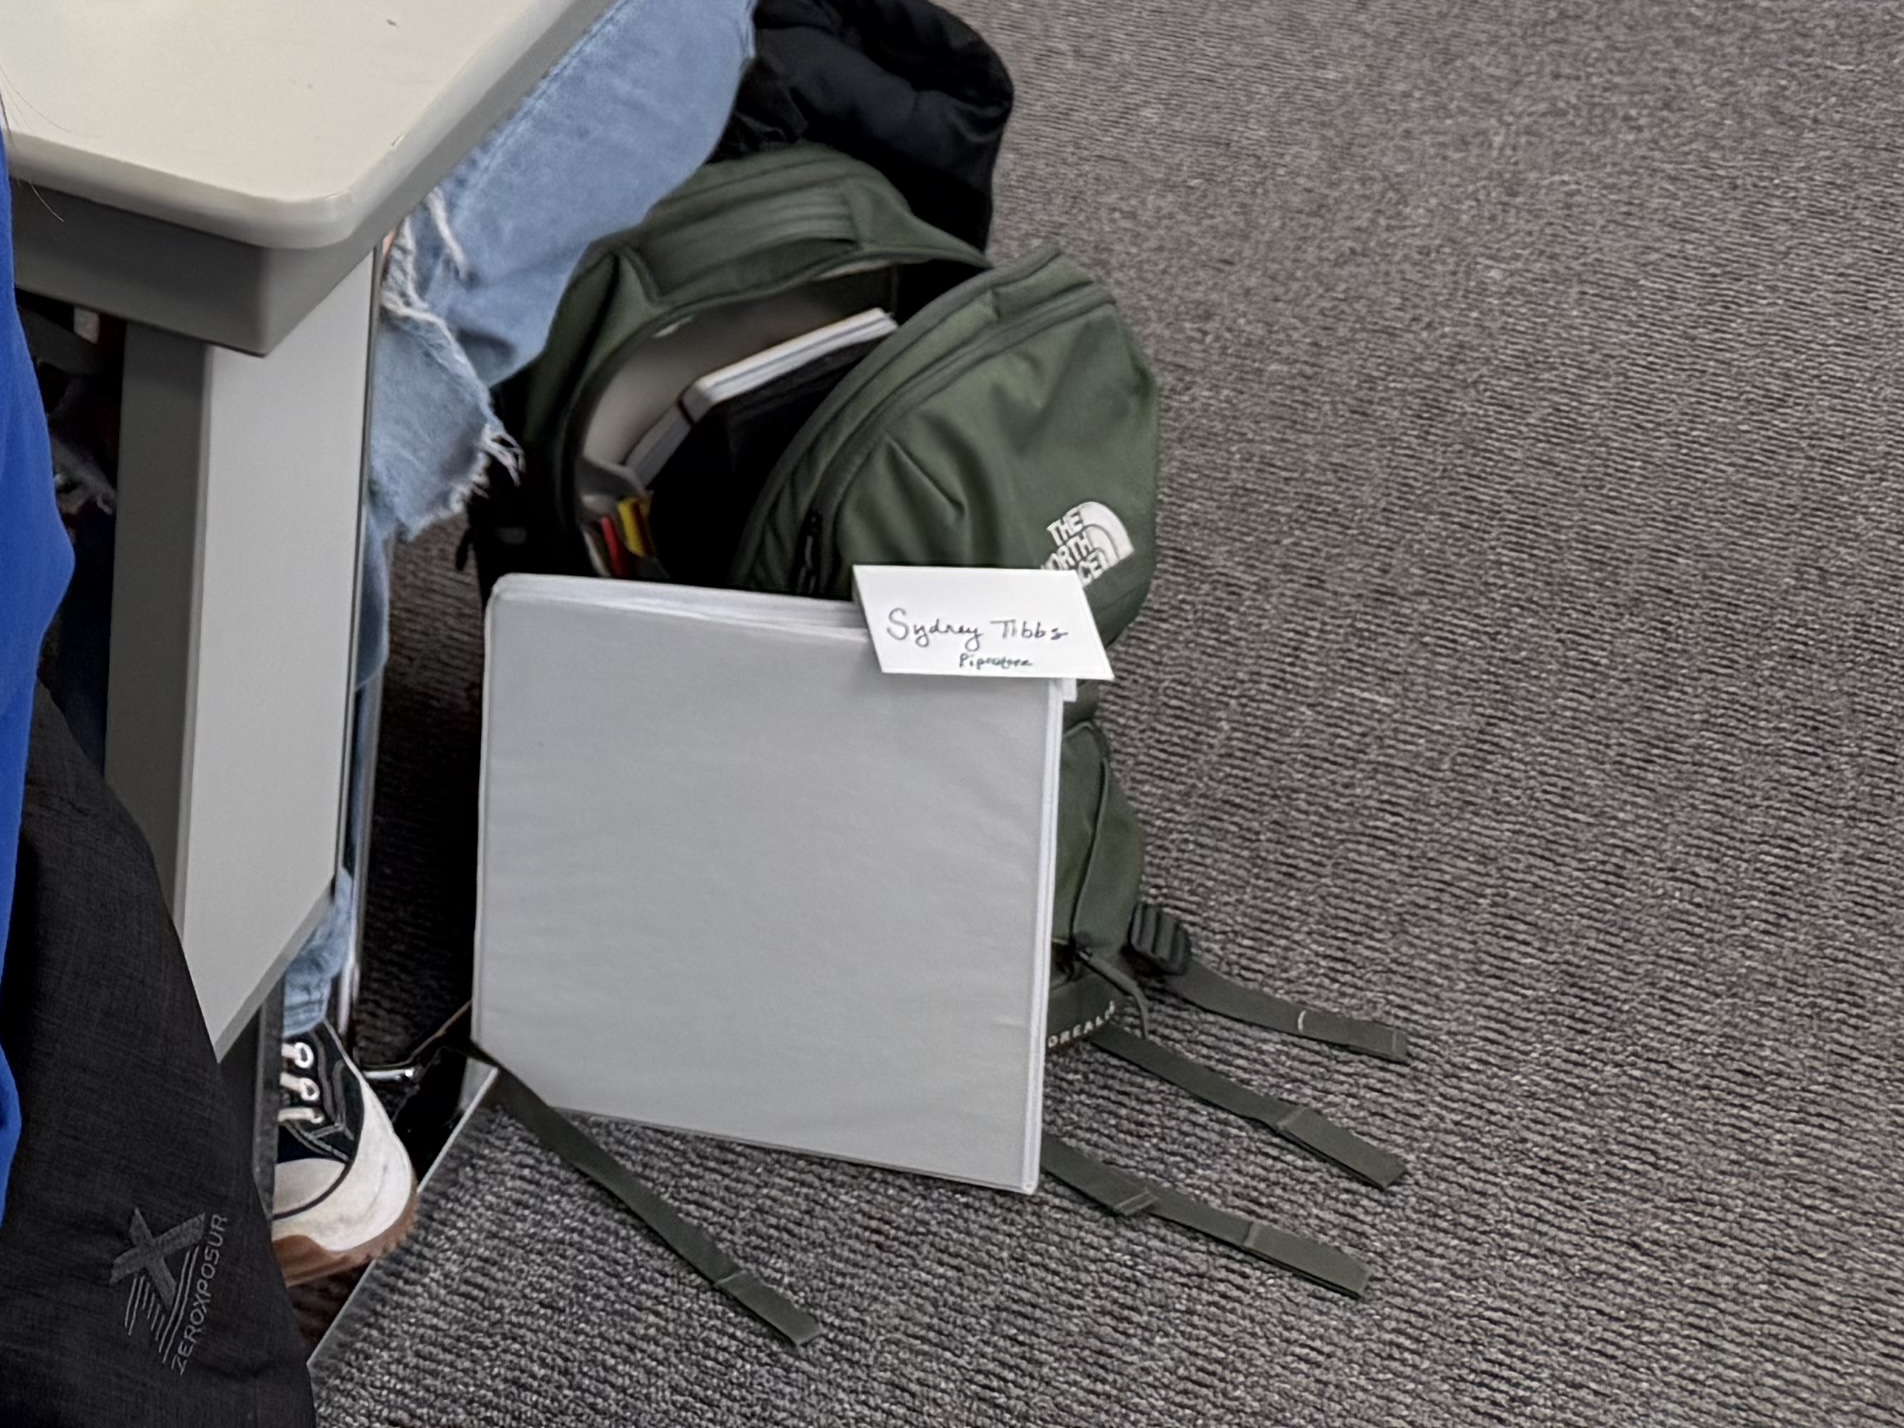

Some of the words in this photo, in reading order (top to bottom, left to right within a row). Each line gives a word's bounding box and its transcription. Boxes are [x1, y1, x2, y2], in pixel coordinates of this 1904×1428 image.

[1046, 508, 1084, 547] THE
[1041, 531, 1093, 571] ORTH
[886, 607, 984, 652] Sydney
[170, 1213, 229, 1377] ZEROXPOSUR
